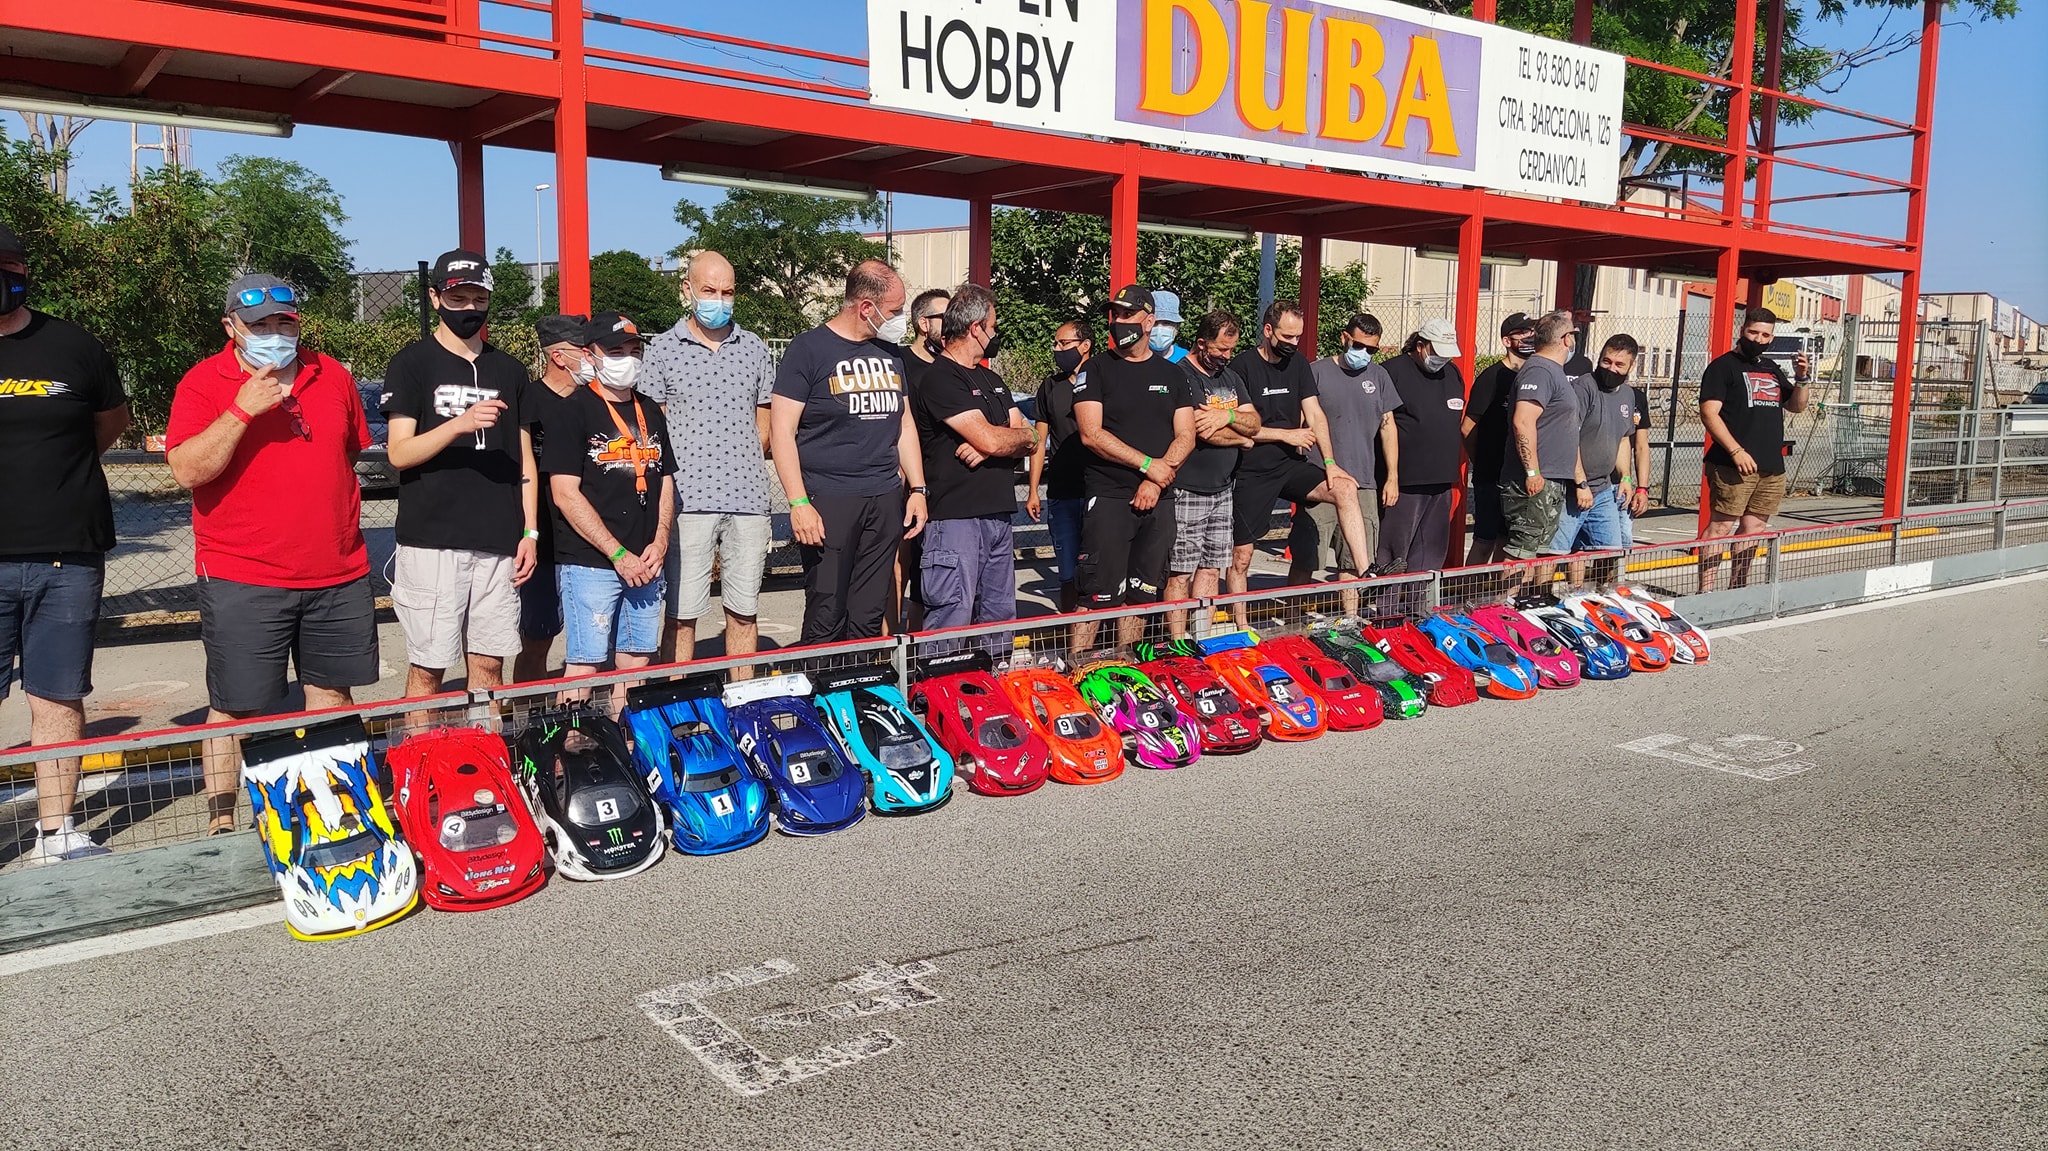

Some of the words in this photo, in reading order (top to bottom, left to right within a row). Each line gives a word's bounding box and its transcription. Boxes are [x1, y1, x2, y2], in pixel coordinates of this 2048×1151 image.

[900, 10, 1074, 112] HOBBY
[1518, 46, 1531, 80] TEL
[1536, 50, 1548, 83] 93
[1550, 54, 1572, 88] 580
[1574, 59, 1586, 91] 84
[1588, 62, 1600, 93] 67
[1137, 0, 1462, 157] DUBA
[1498, 95, 1527, 131] CTRA.
[1531, 102, 1593, 147] BARCELONA,
[1597, 114, 1612, 146] 125
[1518, 148, 1587, 188] CERDANYOLA
[836, 357, 899, 391] CORE
[849, 391, 899, 414] DENIM
[1275, 685, 1285, 696] 2
[1204, 701, 1213, 712] 7
[1146, 713, 1155, 723] 3
[1060, 720, 1070, 731] 9
[743, 738, 752, 750] 3
[794, 765, 806, 778] 3
[652, 773, 660, 785] 1
[601, 801, 614, 816] 3
[717, 797, 728, 811] 1
[448, 822, 461, 834] 4
